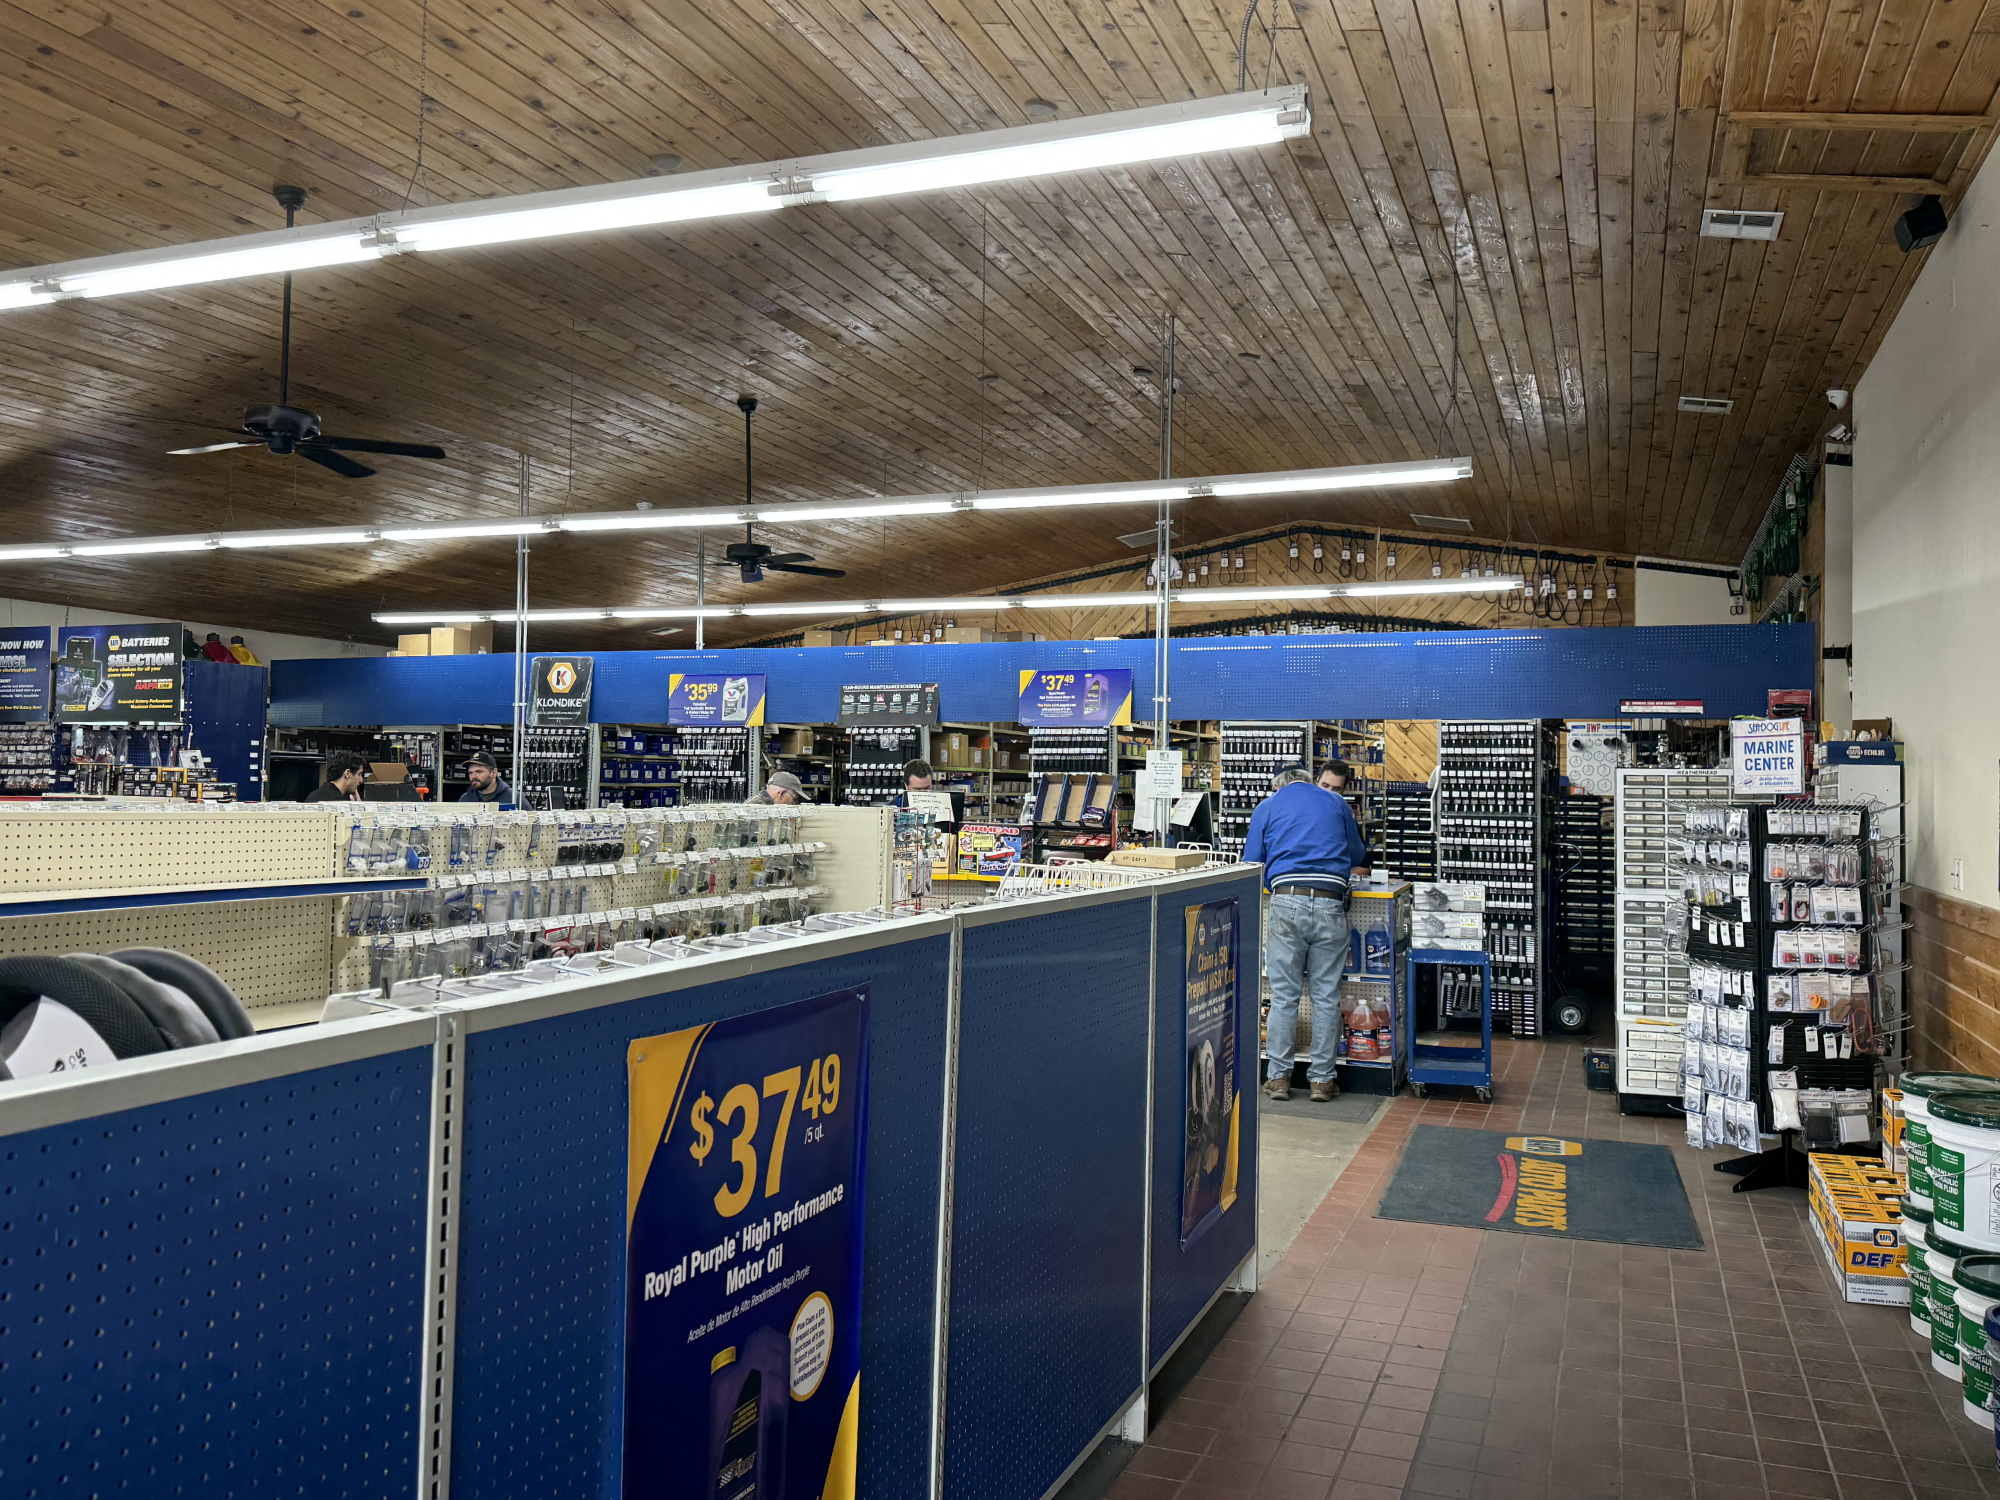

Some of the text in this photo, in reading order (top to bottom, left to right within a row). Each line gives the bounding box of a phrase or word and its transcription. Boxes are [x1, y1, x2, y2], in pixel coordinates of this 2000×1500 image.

[23, 640, 44, 649] HOW
[121, 637, 170, 647] BATTERIES
[0, 655, 26, 667] VICE
[108, 653, 174, 667] SELECTION
[556, 671, 567, 686] K
[536, 698, 583, 707] KLONDIKE
[1586, 723, 1601, 733] BWP
[1744, 740, 1794, 755] MARINE
[1745, 757, 1794, 771] CENTER
[961, 824, 1020, 835] AIRHEAD
[1198, 951, 1214, 973] Claim
[1187, 974, 1209, 1002] Prepaid
[1915, 1156, 1928, 1165] FLUID
[1514, 1157, 1568, 1231] AUTO PARTS
[1943, 1184, 1958, 1195] FLUID
[644, 1257, 687, 1301] Royal
[742, 1218, 771, 1253] High
[774, 1183, 843, 1237] Performance
[1879, 1234, 1892, 1242] NAPA
[1851, 1251, 1894, 1269] DEF
[726, 1243, 783, 1296] Motor Oil
[687, 1325, 707, 1344] Aceite
[707, 1319, 715, 1331] de
[715, 1310, 732, 1328] Motor
[732, 1305, 740, 1317] de
[739, 1298, 751, 1314] Alto
[751, 1282, 782, 1308] Rendimiento
[782, 1273, 796, 1290] Royal
[797, 1322, 805, 1332] Plus
[805, 1315, 815, 1326] Claim
[1939, 1317, 1954, 1329] FLUID
[796, 1329, 809, 1345] prepaid
[809, 1322, 817, 1334] card
[794, 1351, 807, 1366] Submit
